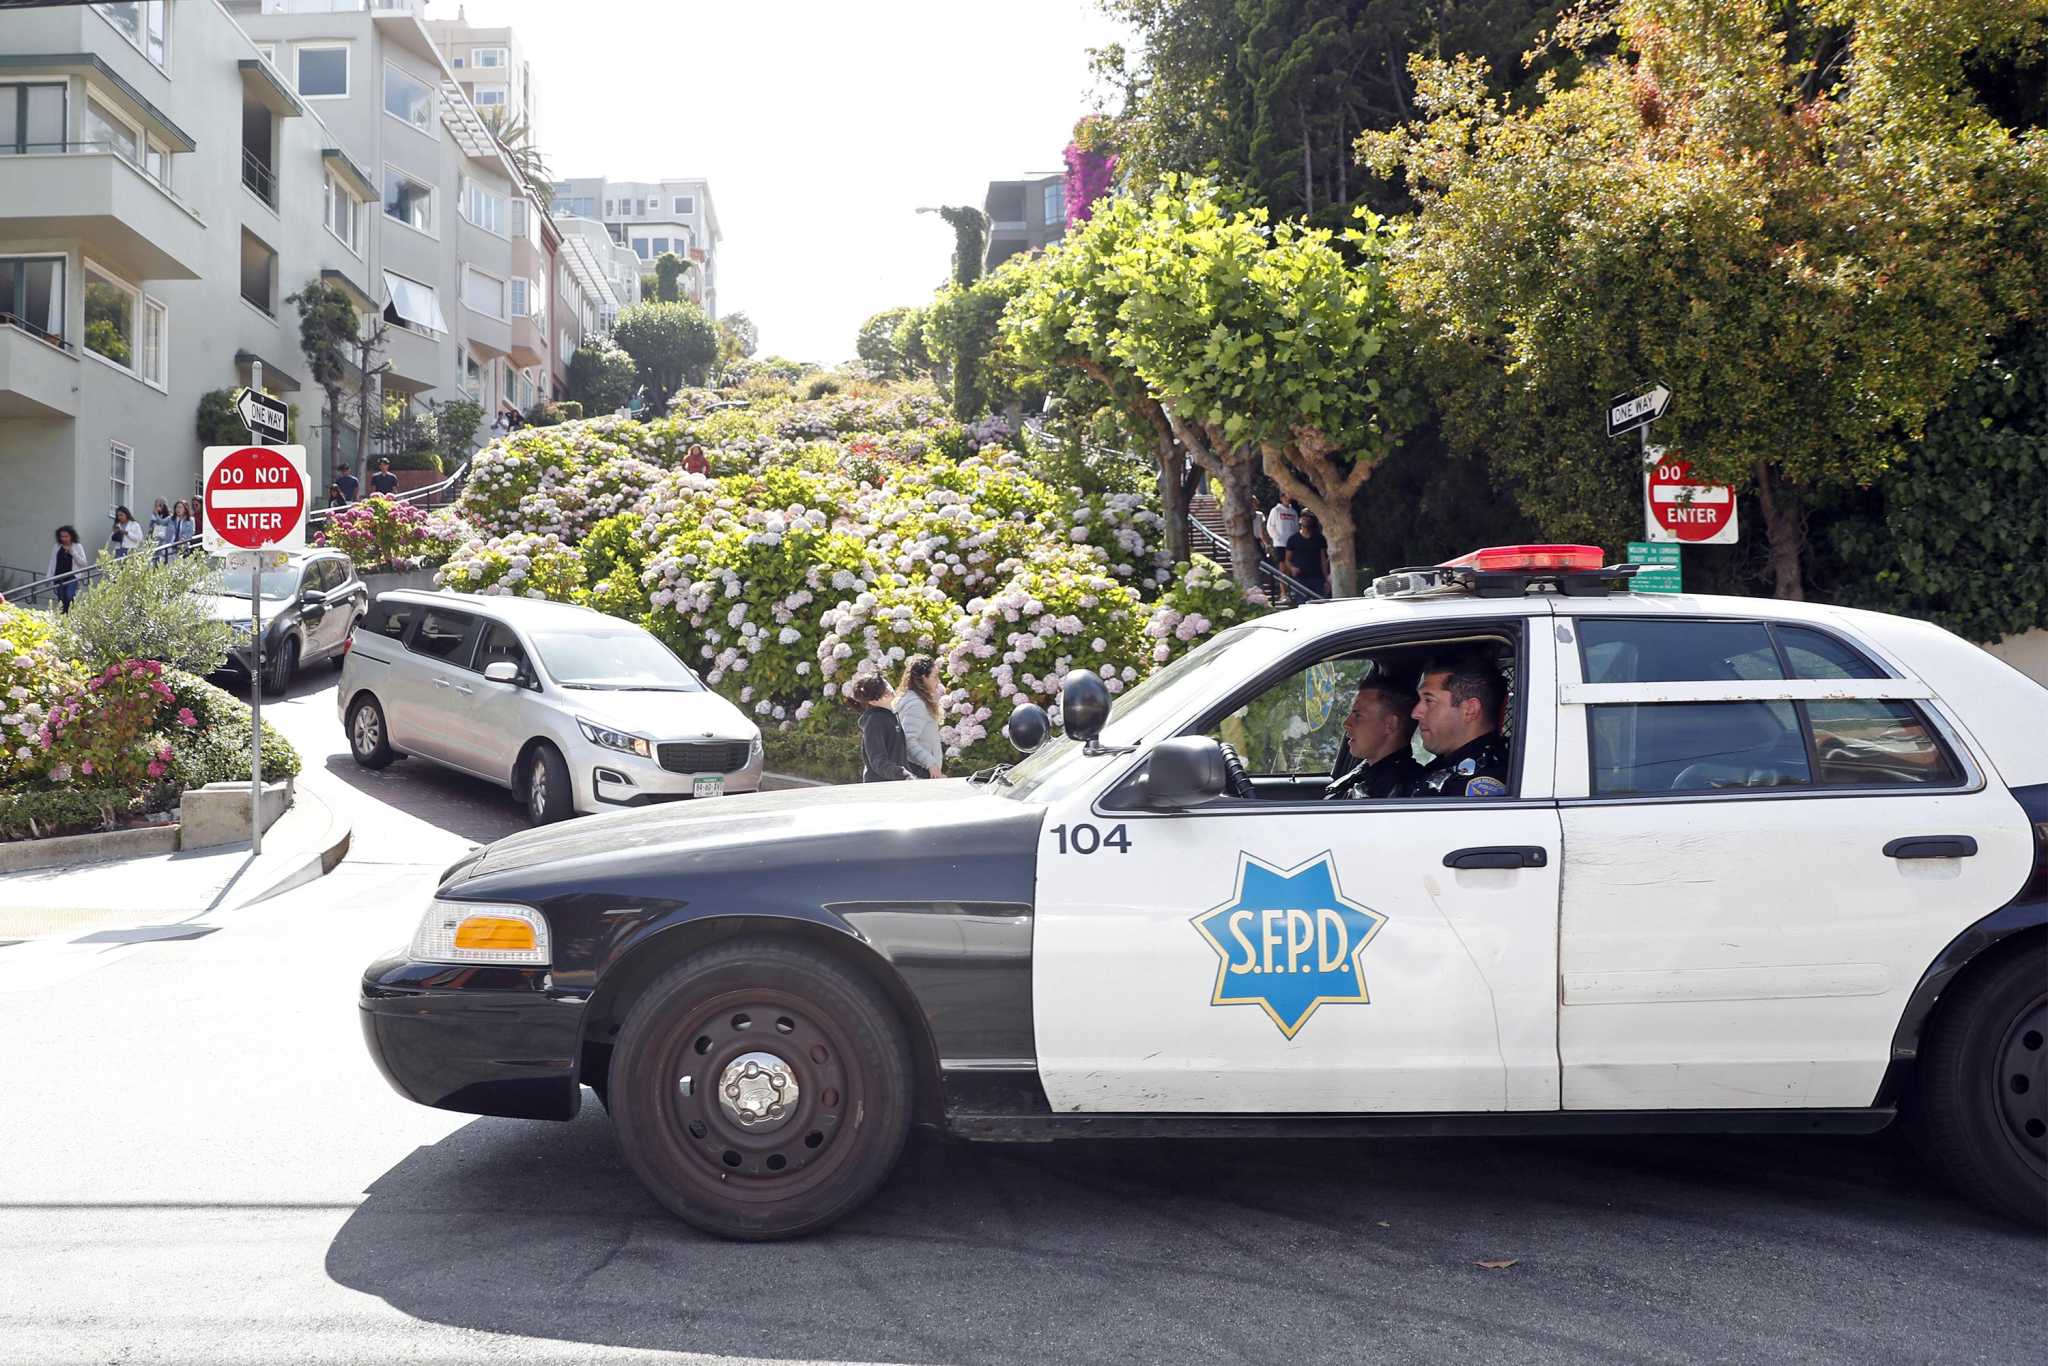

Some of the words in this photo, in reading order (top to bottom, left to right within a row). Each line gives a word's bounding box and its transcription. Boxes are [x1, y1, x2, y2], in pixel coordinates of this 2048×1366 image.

[251, 403, 265, 423] ONE
[267, 410, 283, 428] WAY
[1615, 402, 1633, 422] ONE
[1635, 393, 1653, 413] WAY
[220, 468, 244, 484] DO
[255, 467, 290, 484] NOT
[1659, 465, 1681, 481] DO
[226, 513, 282, 530] ENTER
[1667, 507, 1717, 524] ENTER
[1050, 823, 1133, 855] 104
[1228, 909, 1350, 975] S.F.P.D.
